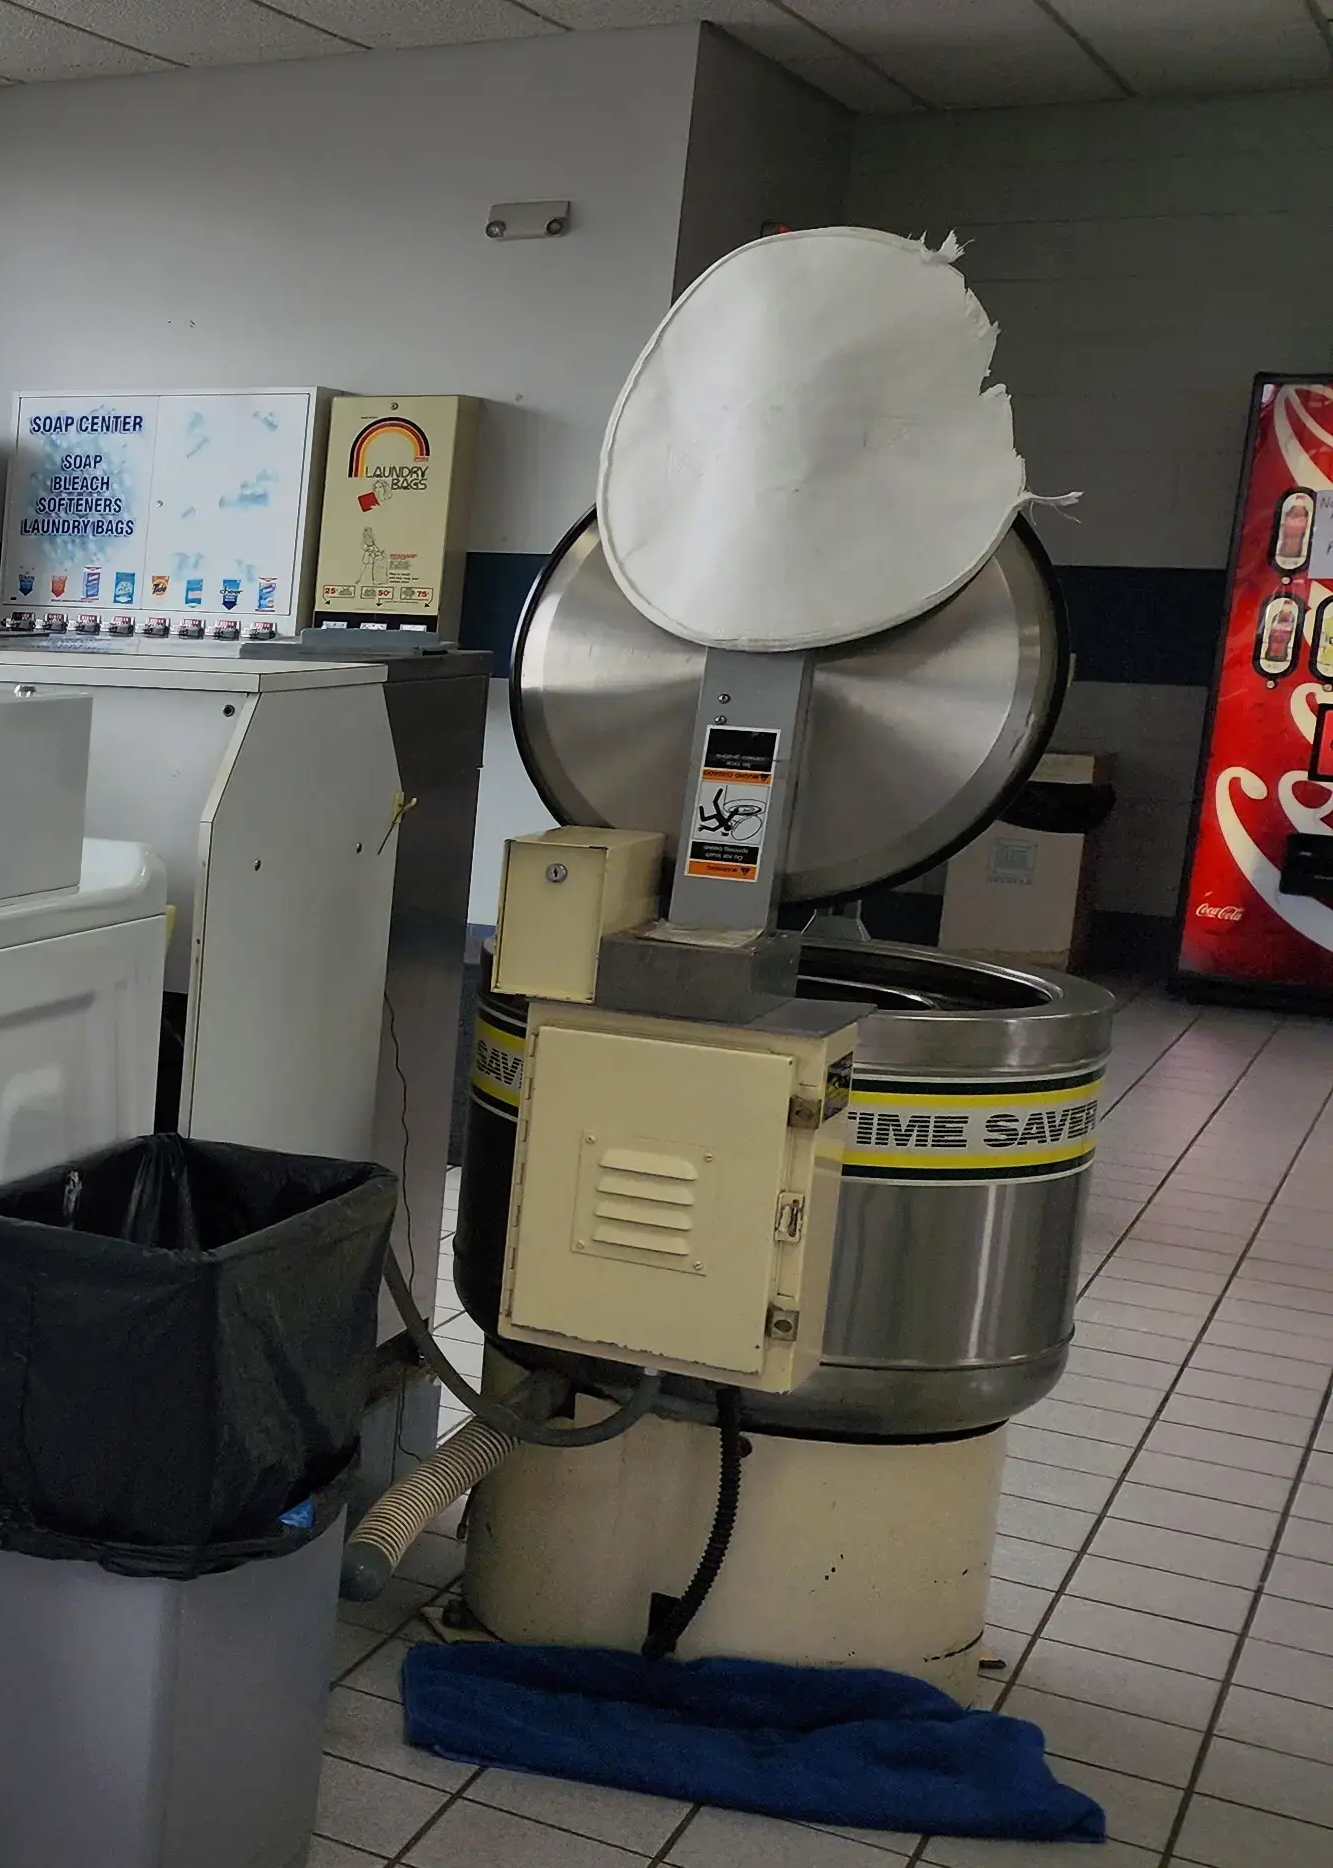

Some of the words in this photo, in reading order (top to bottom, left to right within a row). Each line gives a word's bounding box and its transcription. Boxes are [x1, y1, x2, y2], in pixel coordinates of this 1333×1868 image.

[30, 415, 75, 434] SOAP
[76, 415, 143, 434] CENTER
[61, 454, 103, 471] SOAP
[365, 466, 430, 479] LAUNDRY
[51, 475, 110, 493] BLEACH
[391, 478, 428, 491] BAGS
[35, 497, 122, 515] SOFTENERS
[20, 519, 91, 536] LAUNDRY
[92, 519, 135, 537] BAGS
[152, 582, 168, 595] Tide
[477, 1039, 524, 1089] SAV
[847, 1111, 970, 1148] IME
[983, 1099, 1098, 1149] SAVER
